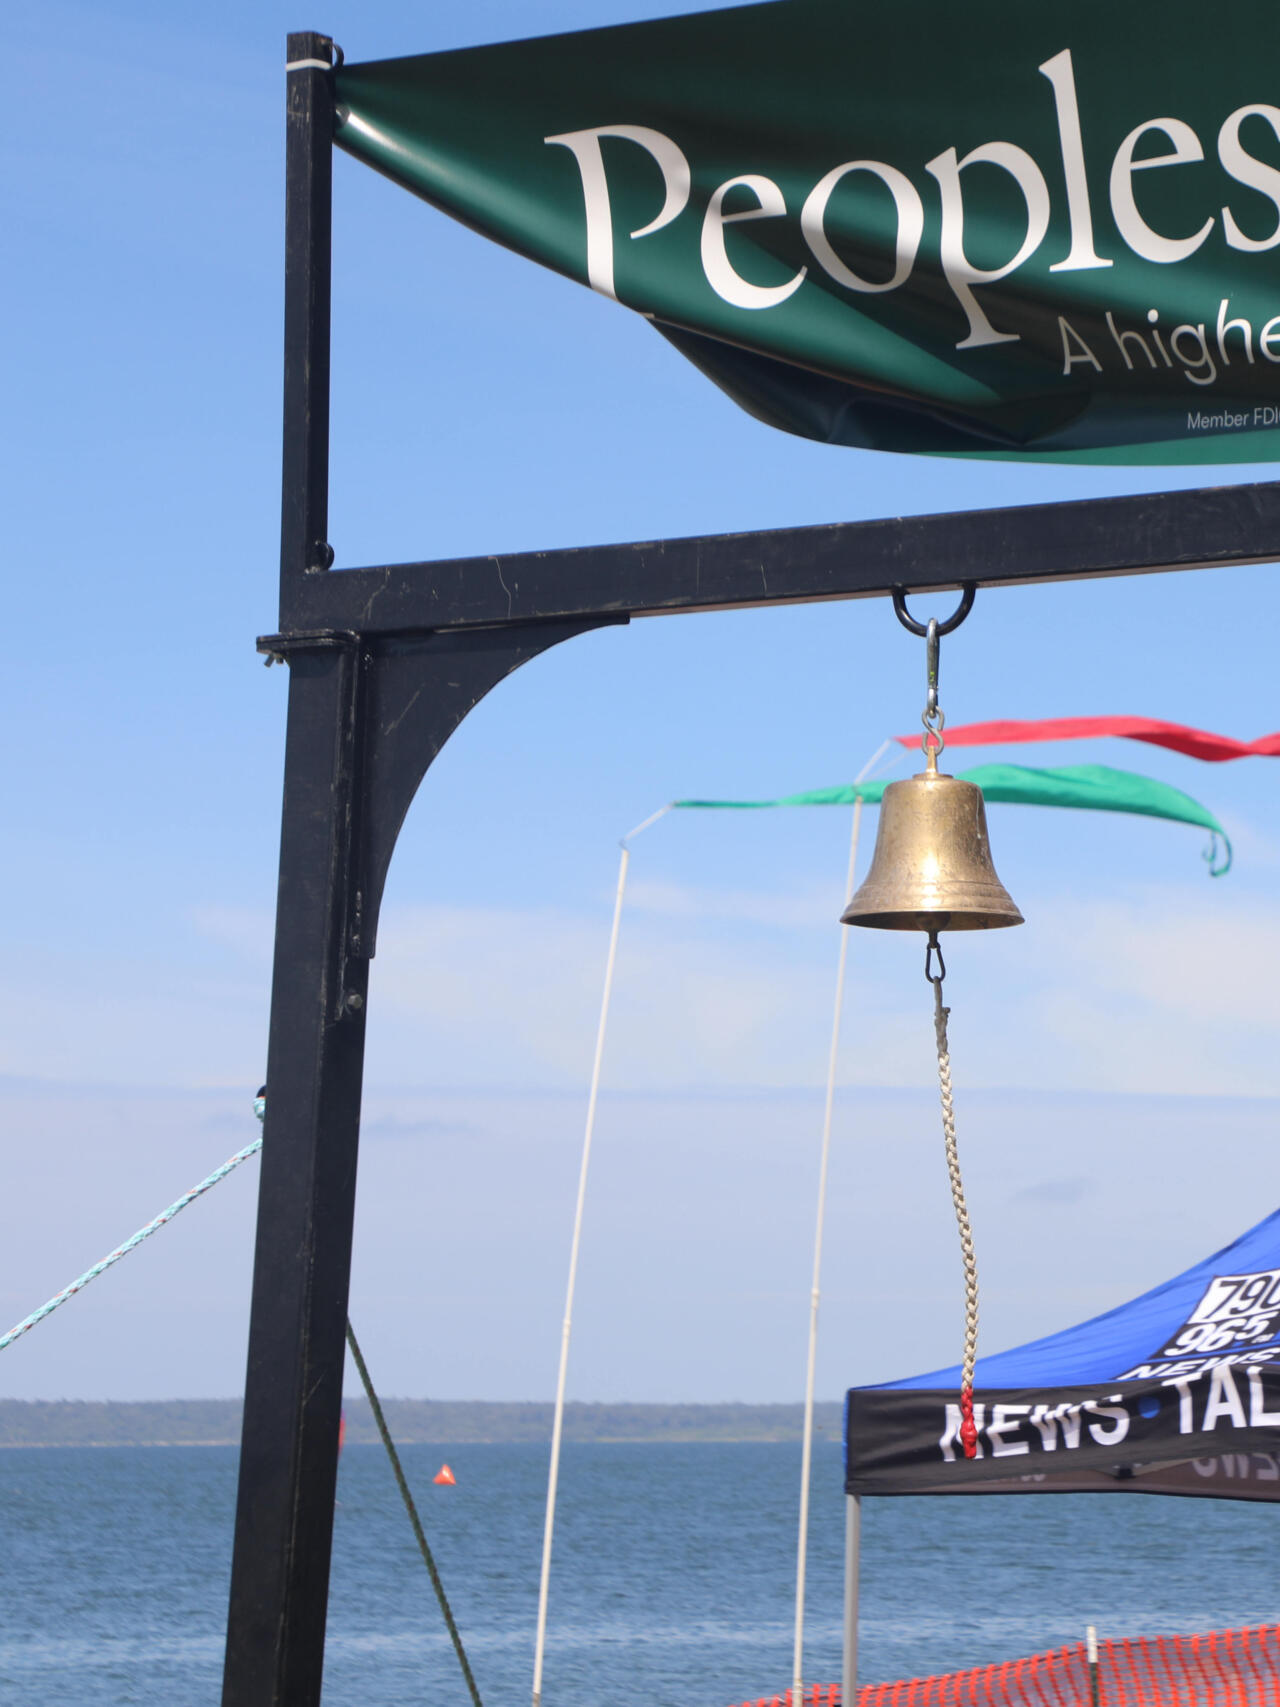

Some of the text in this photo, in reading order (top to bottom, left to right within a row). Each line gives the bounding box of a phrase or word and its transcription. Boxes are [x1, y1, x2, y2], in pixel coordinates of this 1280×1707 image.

[1057, 315, 1103, 375] A
[1186, 412, 1249, 430] Member
[939, 1394, 1130, 1462] NEWS
